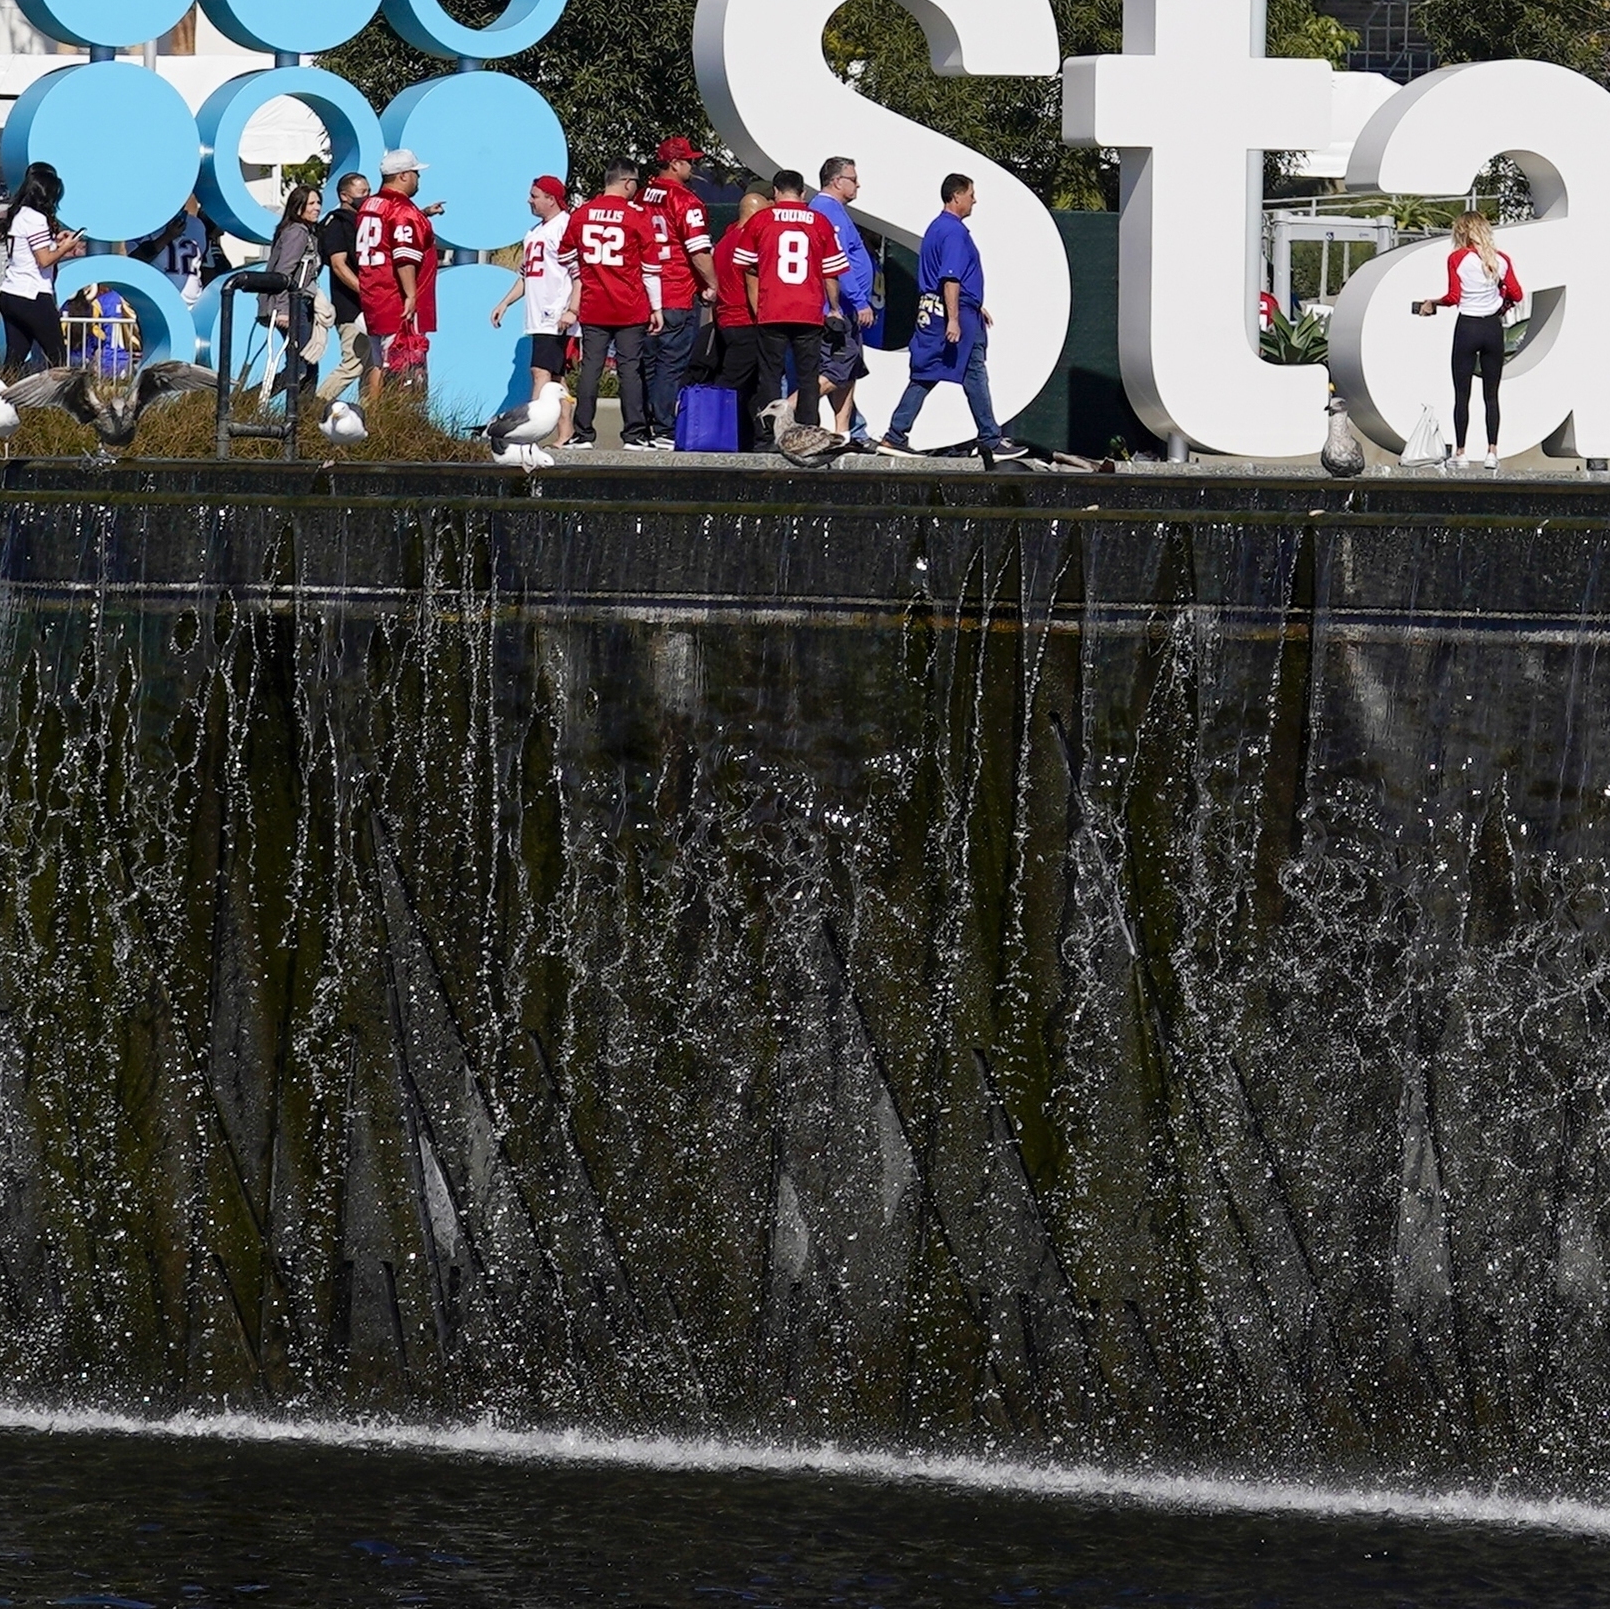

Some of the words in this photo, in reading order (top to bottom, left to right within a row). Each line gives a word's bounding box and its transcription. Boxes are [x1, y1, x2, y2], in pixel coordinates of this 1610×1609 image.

[588, 208, 625, 224] WILLIS
[685, 208, 705, 228] 42
[772, 208, 815, 225] YOUNG
[356, 215, 386, 267] 42
[393, 224, 414, 244] 42
[581, 223, 626, 267] 52
[164, 238, 199, 276] 12
[777, 229, 810, 286] 8
